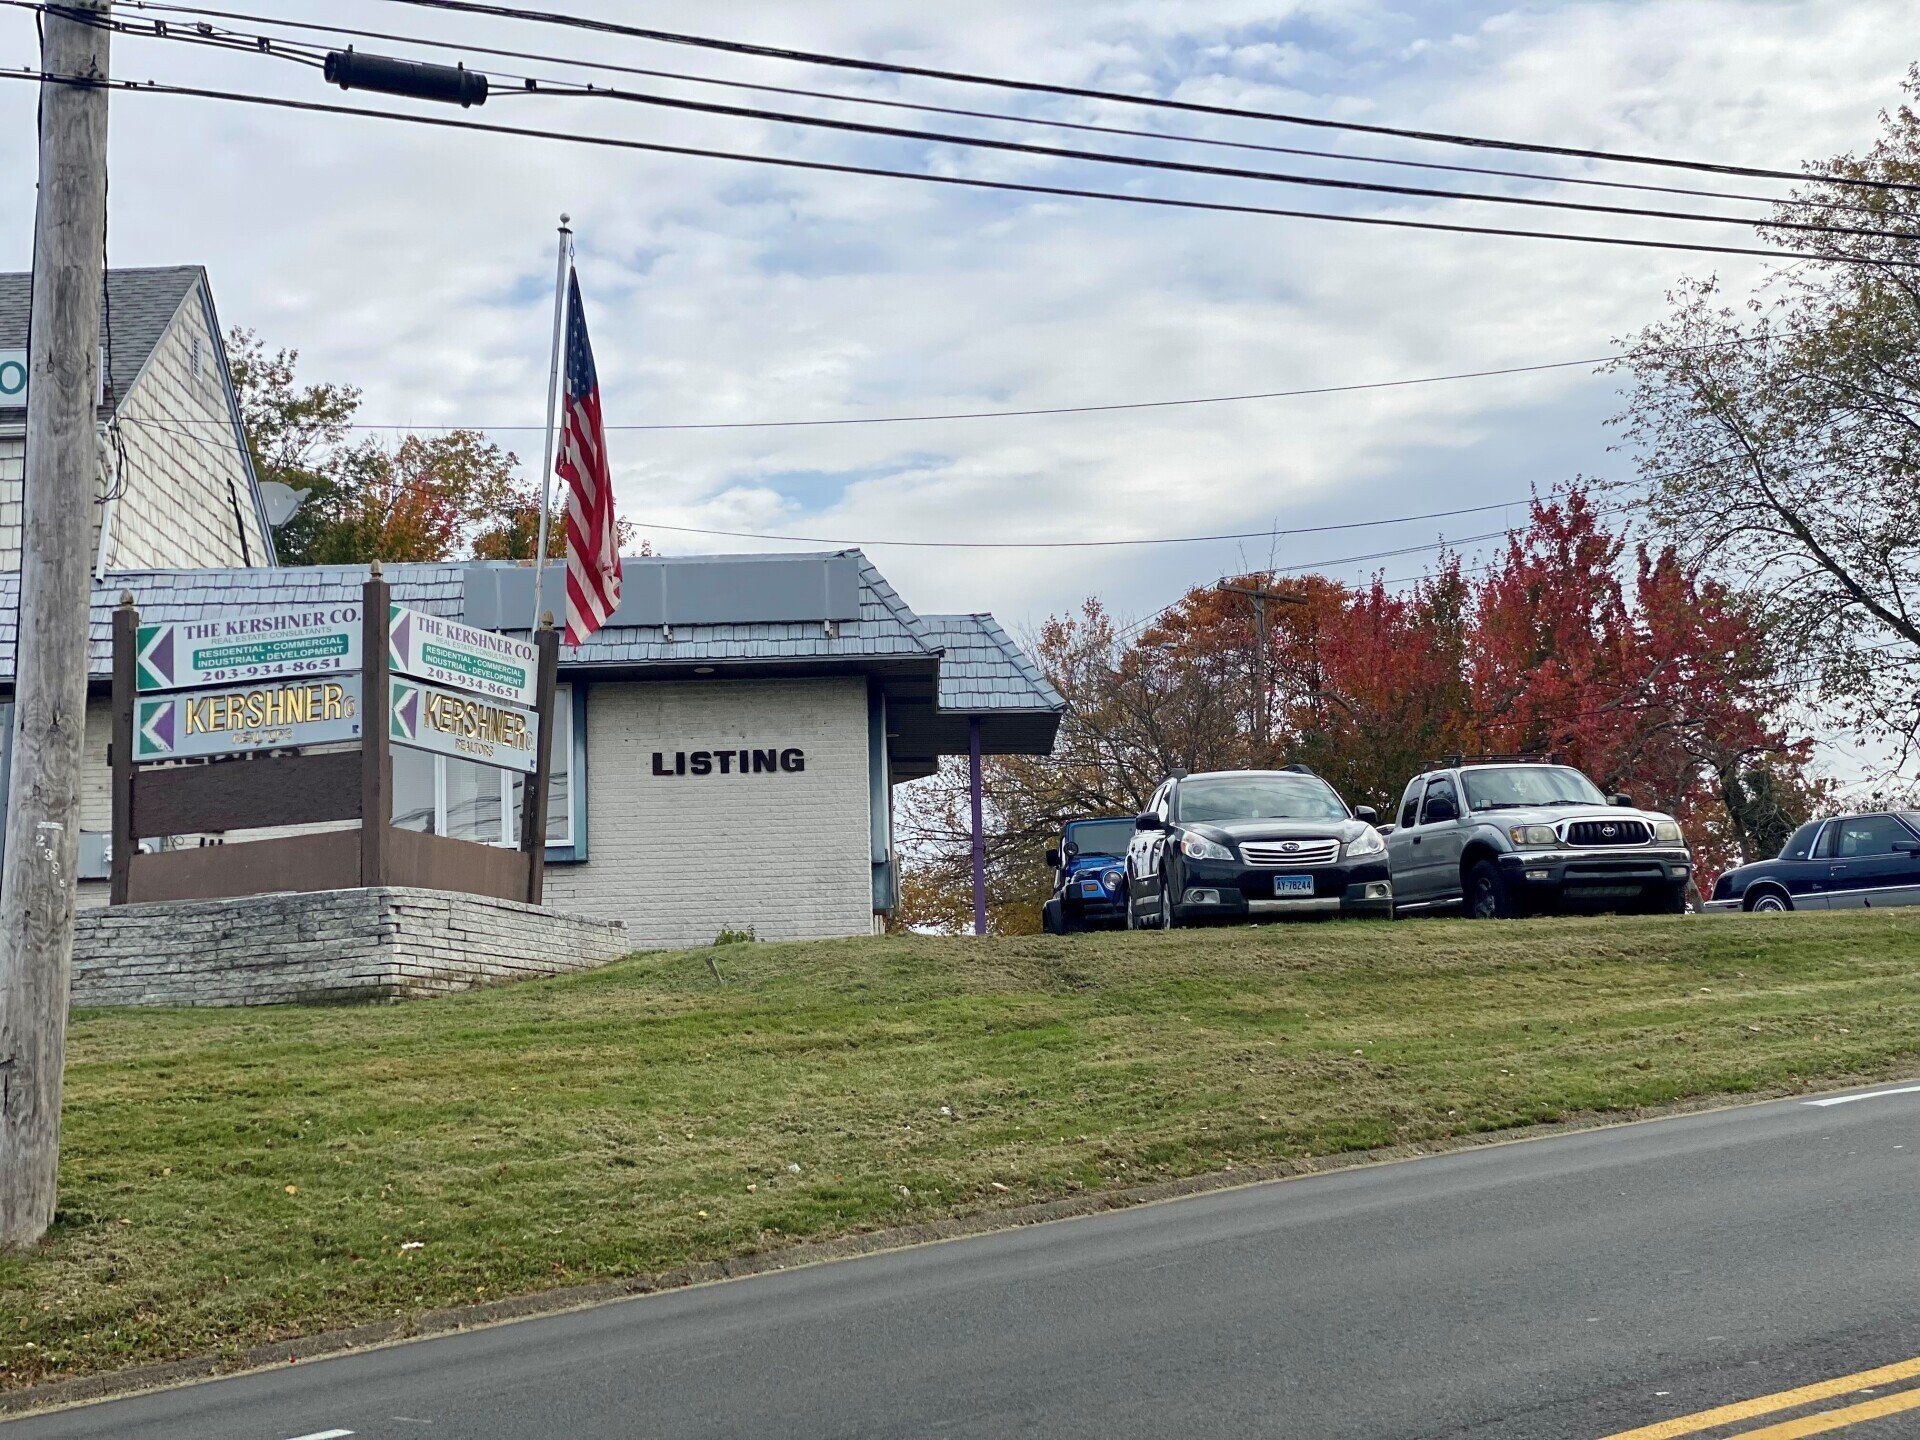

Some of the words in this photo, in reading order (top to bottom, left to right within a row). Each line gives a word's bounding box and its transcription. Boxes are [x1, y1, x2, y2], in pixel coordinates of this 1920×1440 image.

[184, 623, 221, 640] THE
[226, 611, 326, 636] KERSHNER
[330, 608, 362, 624] CO.
[211, 637, 234, 645] REAL
[235, 633, 267, 642] ESTATE
[269, 627, 332, 639] CONSULTANTS
[199, 645, 265, 659] RESIDENTIAL
[273, 636, 343, 651] COMMERCIAL
[417, 617, 443, 636] THE
[446, 625, 512, 655] KERSHNER
[515, 644, 535, 661] CO.
[436, 637, 452, 646] REAL
[453, 642, 474, 652] ESTATE
[475, 647, 516, 664] CONSULTANTS
[198, 655, 259, 668] INDUSTRIAL
[267, 645, 344, 661] DEVELOPMENT
[202, 657, 342, 682] 203-934-8651
[425, 655, 467, 671] INDUSTRIAL
[472, 667, 523, 685] DEVELOPMENT
[426, 645, 472, 664] RESIDENTIAL
[477, 659, 522, 677] COMMERCIAL
[427, 667, 520, 699] 203-934-8651
[184, 683, 343, 736] KERSHNER
[424, 691, 526, 750] KERSHNER
[455, 738, 494, 756] REALTORS
[652, 748, 805, 776] LISTING
